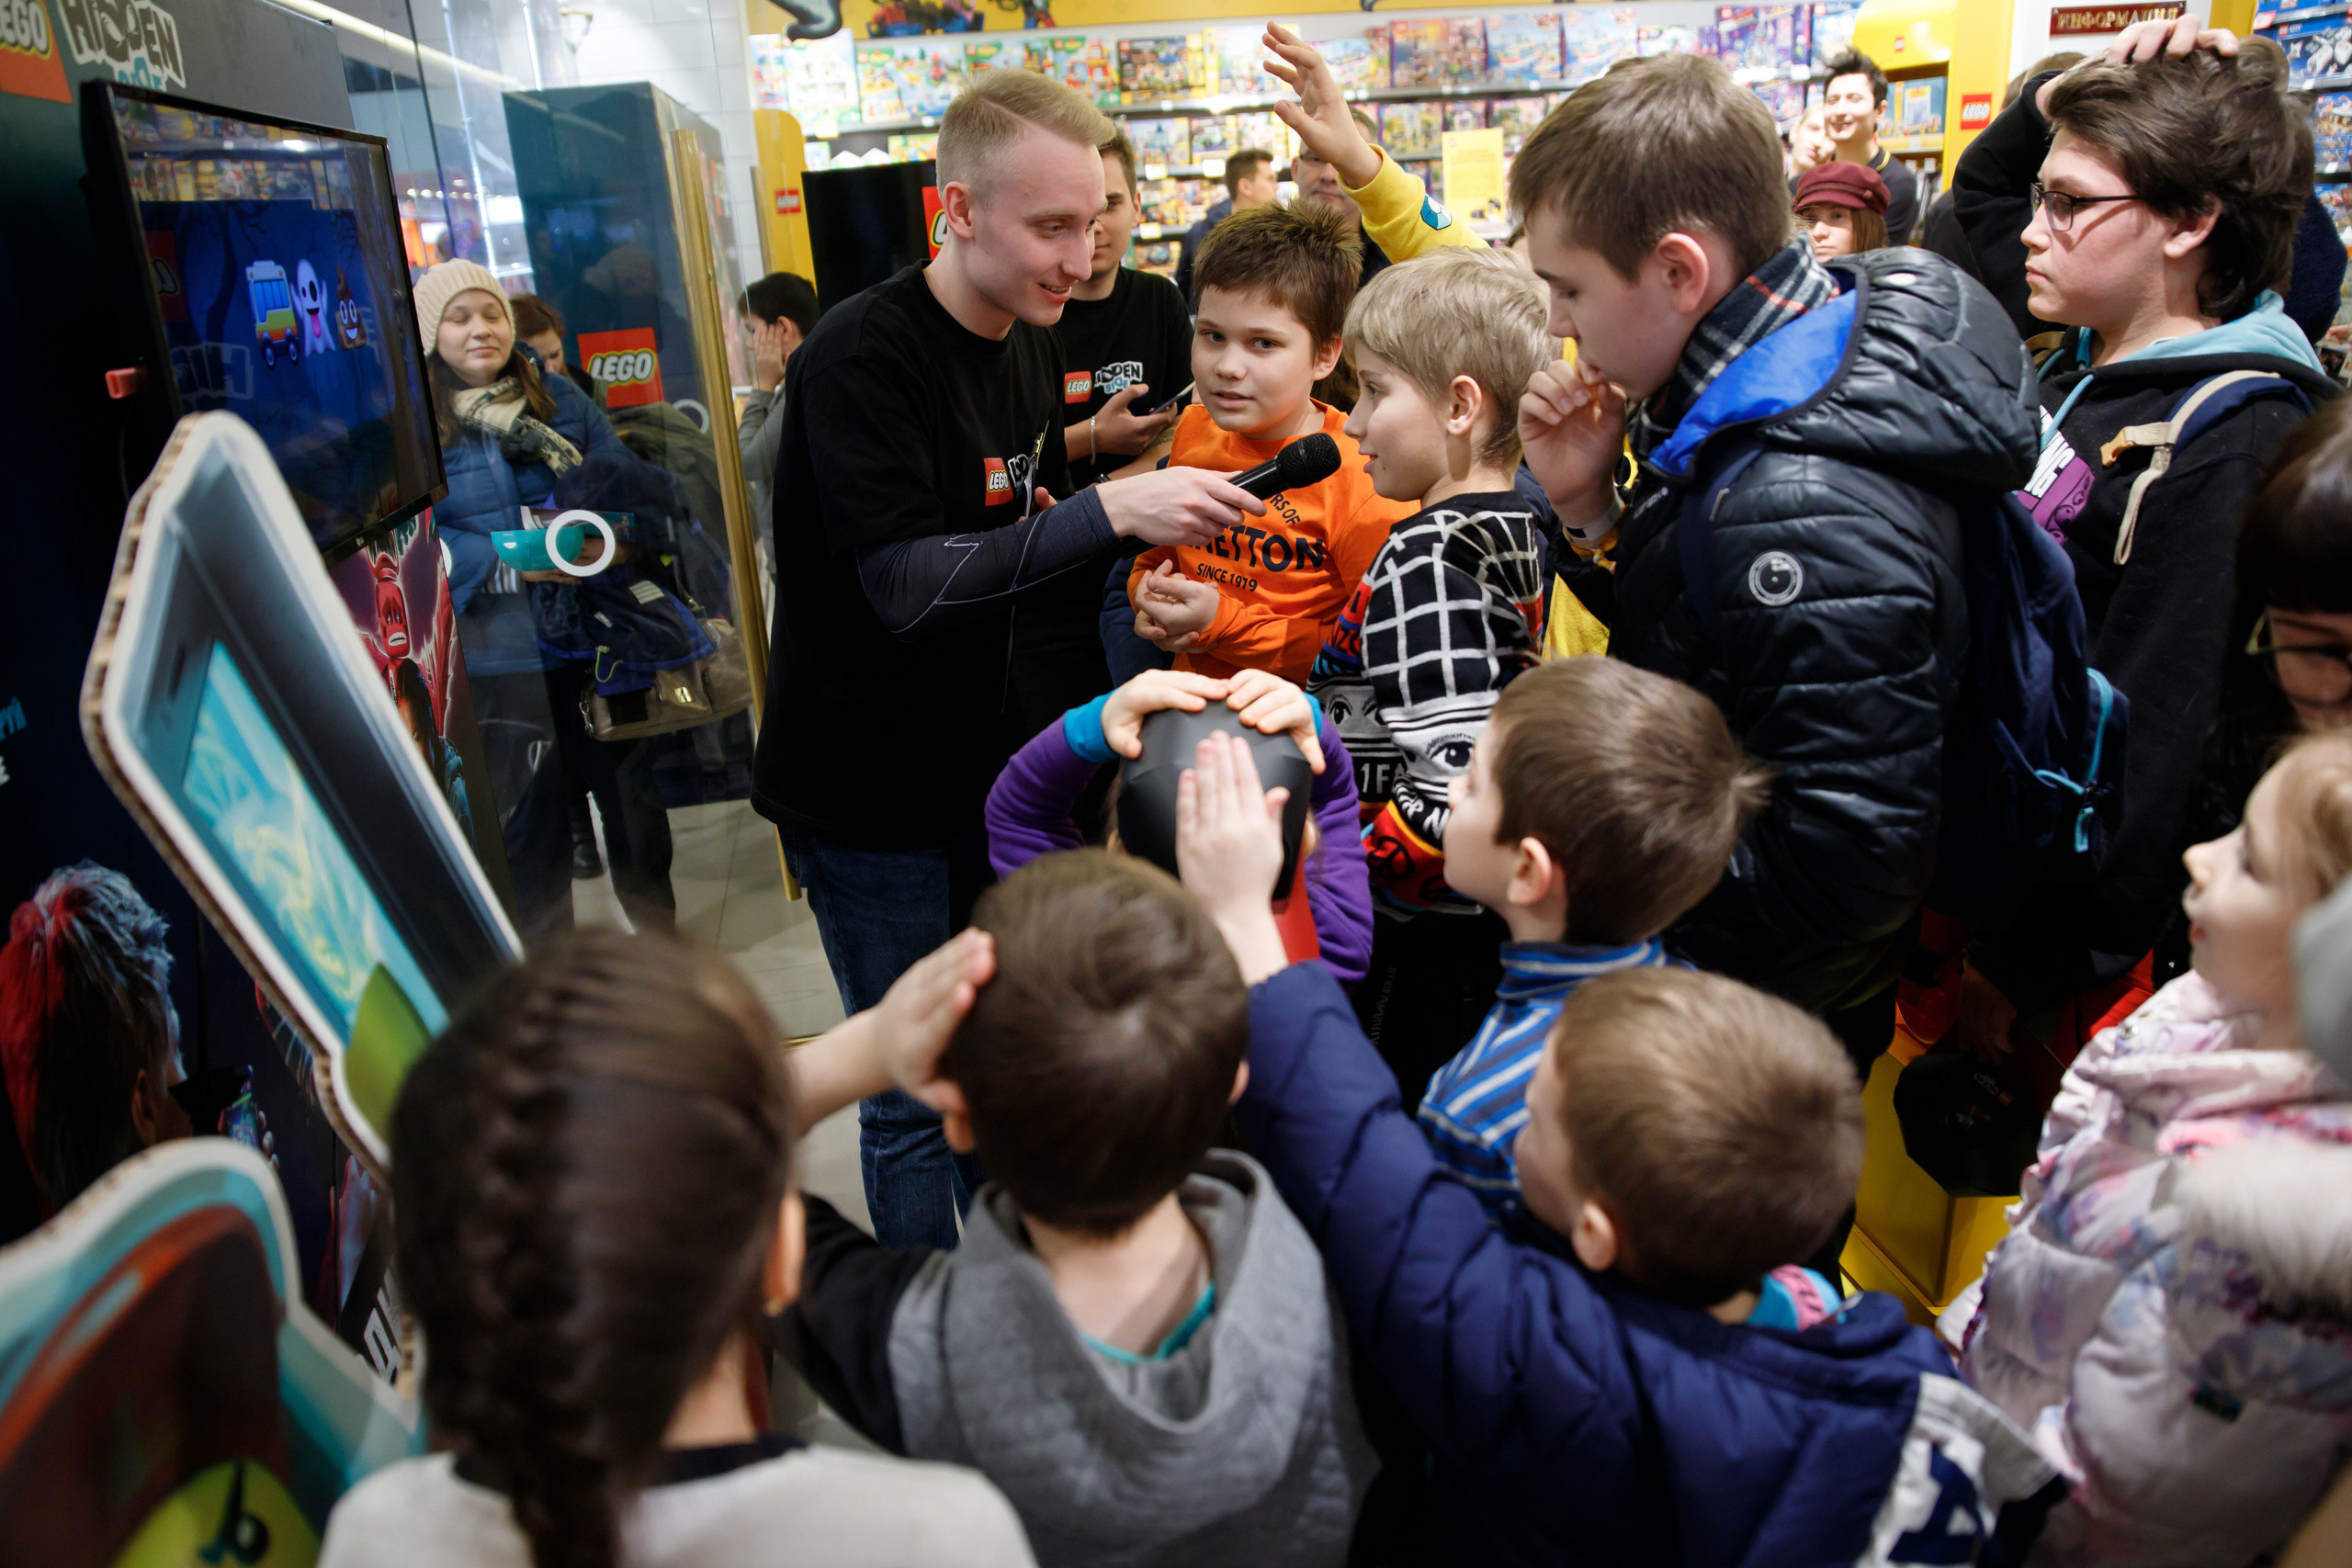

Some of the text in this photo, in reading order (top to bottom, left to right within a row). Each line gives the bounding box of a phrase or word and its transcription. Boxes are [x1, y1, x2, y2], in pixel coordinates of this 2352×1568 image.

[0, 0, 51, 55] EGO
[1962, 102, 1991, 120] LEGO
[589, 351, 654, 383] LEGO
[1066, 379, 1091, 394] LEGO
[988, 471, 1010, 491] LEGO
[1282, 508, 1301, 525] OF
[1188, 524, 1327, 572] ETTON
[1196, 562, 1258, 592] SINCE 1979
